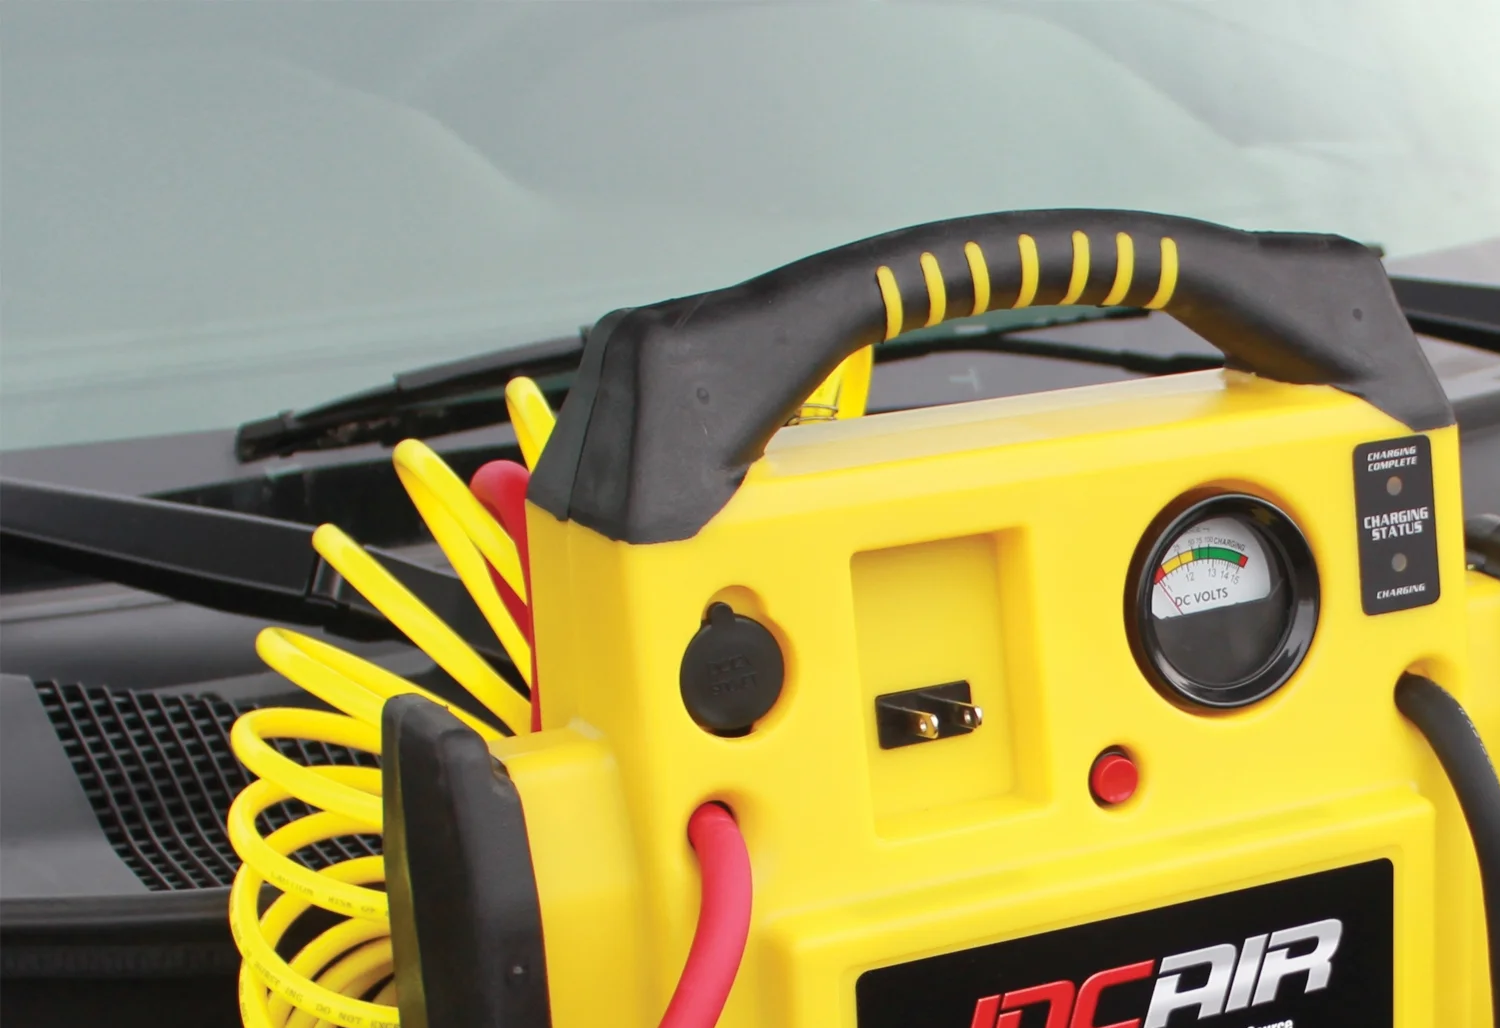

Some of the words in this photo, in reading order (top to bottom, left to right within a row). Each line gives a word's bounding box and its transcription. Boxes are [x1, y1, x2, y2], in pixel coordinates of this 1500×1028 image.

[1367, 445, 1417, 461] CHARGING
[1367, 456, 1417, 472] COMPLETE
[1363, 506, 1429, 529] CHARGING
[1371, 520, 1423, 541] STATUS
[1213, 536, 1246, 552] CHARGING
[1185, 572, 1195, 583] 12
[1207, 568, 1217, 578] 13
[1220, 570, 1229, 580] 14
[1230, 574, 1240, 585] 15
[1175, 594, 1191, 608] DC
[1193, 587, 1229, 604] VOLTS
[1376, 582, 1426, 600] CHARGING
[315, 1003, 332, 1015] DO
[338, 1011, 364, 1026] NOT
